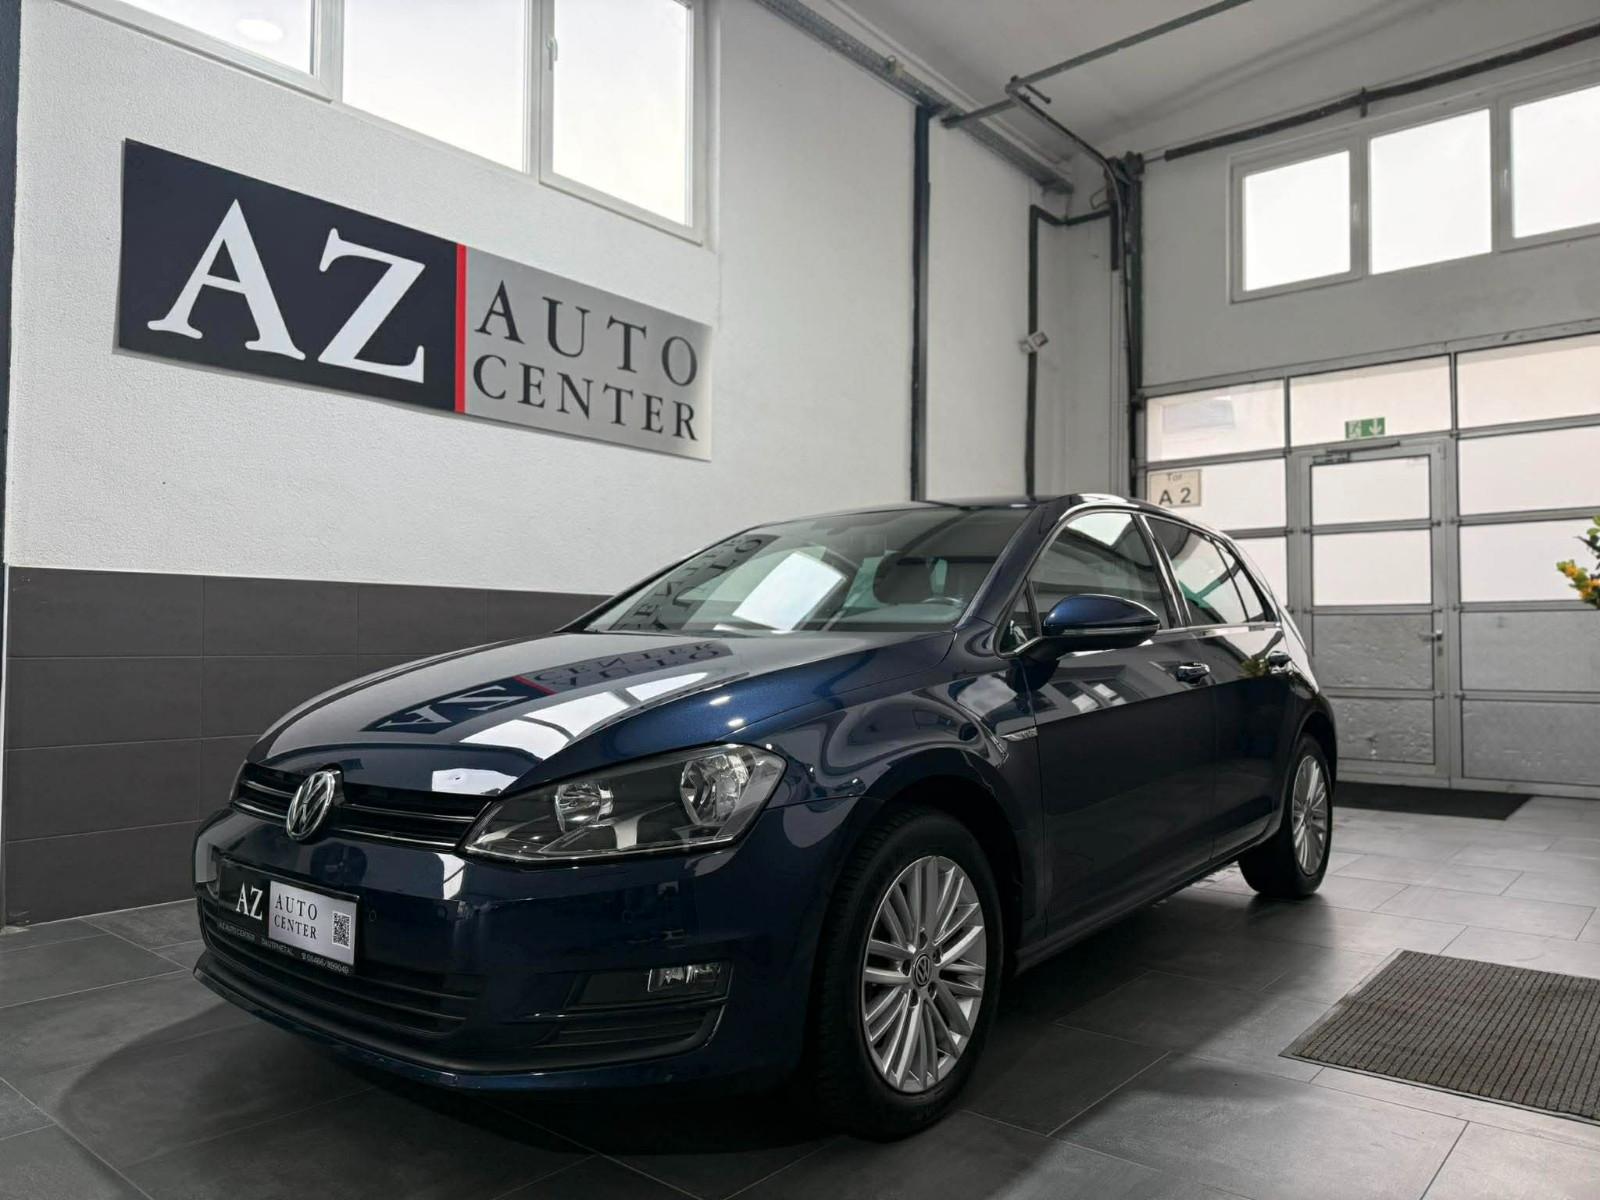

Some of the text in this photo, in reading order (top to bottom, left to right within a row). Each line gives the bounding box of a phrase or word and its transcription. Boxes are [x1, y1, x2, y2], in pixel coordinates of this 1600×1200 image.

[147, 199, 426, 383] AZ
[475, 280, 698, 387] AUTO
[473, 354, 699, 441] CENTER
[235, 881, 263, 920] AZ
[274, 914, 318, 940] CENTER
[275, 893, 318, 921] AUTO
